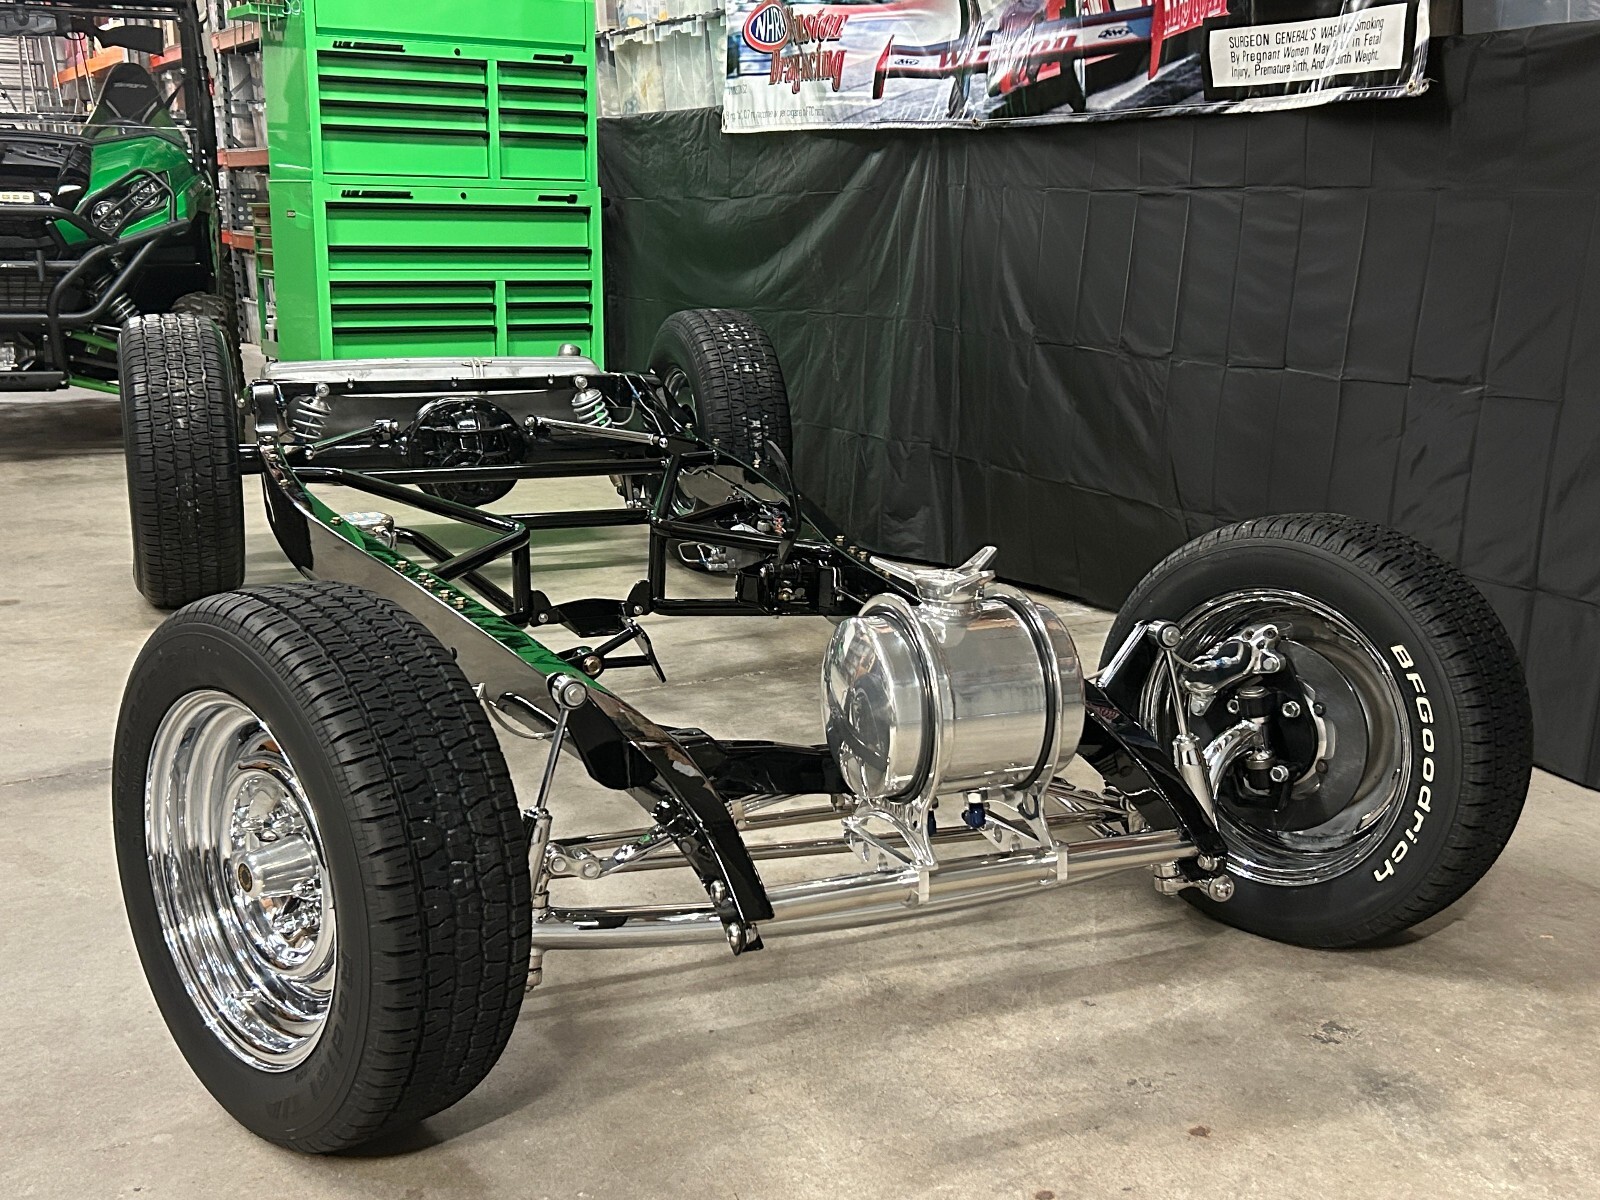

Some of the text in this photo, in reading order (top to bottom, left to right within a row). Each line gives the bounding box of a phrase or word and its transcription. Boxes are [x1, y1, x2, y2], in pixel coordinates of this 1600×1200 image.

[755, 6, 786, 42] NHRA
[1229, 33, 1270, 48] SURGEON
[1275, 28, 1317, 45] GENERAL'S
[1230, 51, 1240, 65] By
[1242, 50, 1281, 63] Pregnant
[1283, 46, 1309, 58] Women
[1313, 42, 1330, 56] May
[1352, 36, 1360, 47] in
[1364, 32, 1382, 46] Fetal
[1254, 64, 1290, 76] Premature
[1311, 57, 1325, 70] And
[1373, 644, 1436, 882] BFGoodrich
